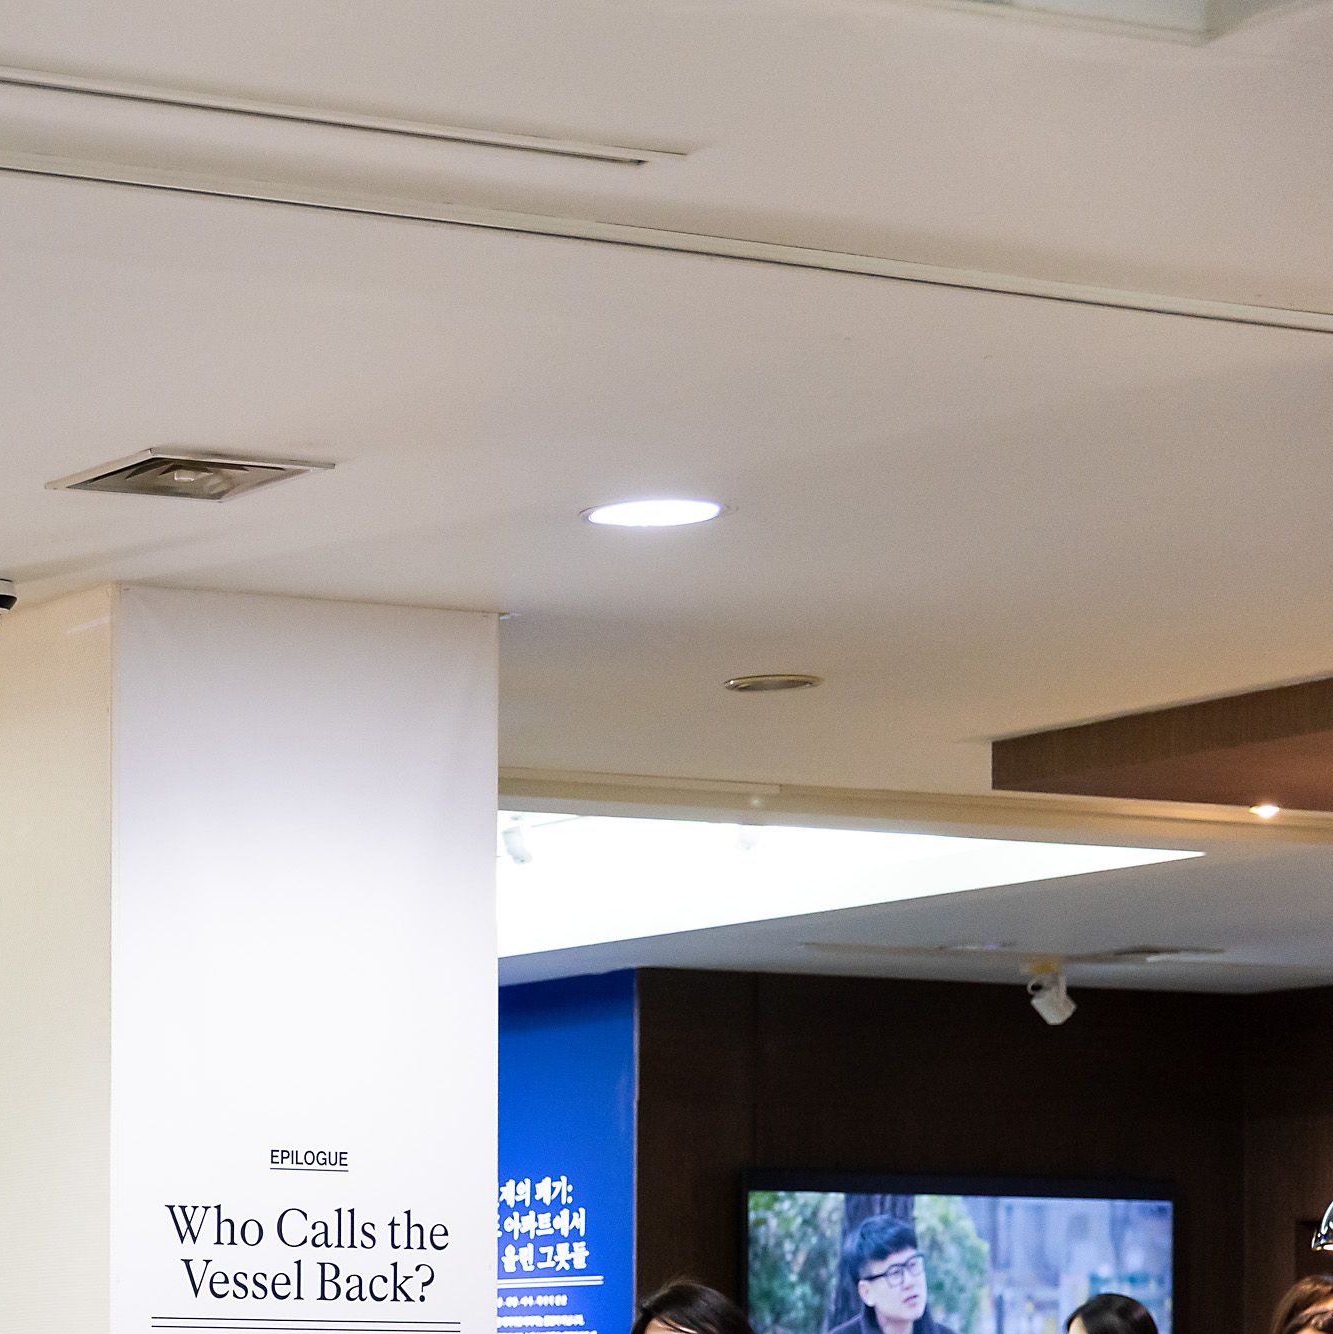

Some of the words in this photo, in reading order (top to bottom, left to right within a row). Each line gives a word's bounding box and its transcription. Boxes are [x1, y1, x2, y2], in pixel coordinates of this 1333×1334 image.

[269, 1149, 349, 1167] EPILOGUE
[164, 1203, 264, 1247] Who
[276, 1207, 377, 1250] Calls
[387, 1209, 449, 1251] the
[503, 1207, 586, 1241] 아파트에서
[537, 1241, 590, 1272] 그릇들
[180, 1258, 305, 1301] Vessel
[316, 1261, 435, 1303] Back?
